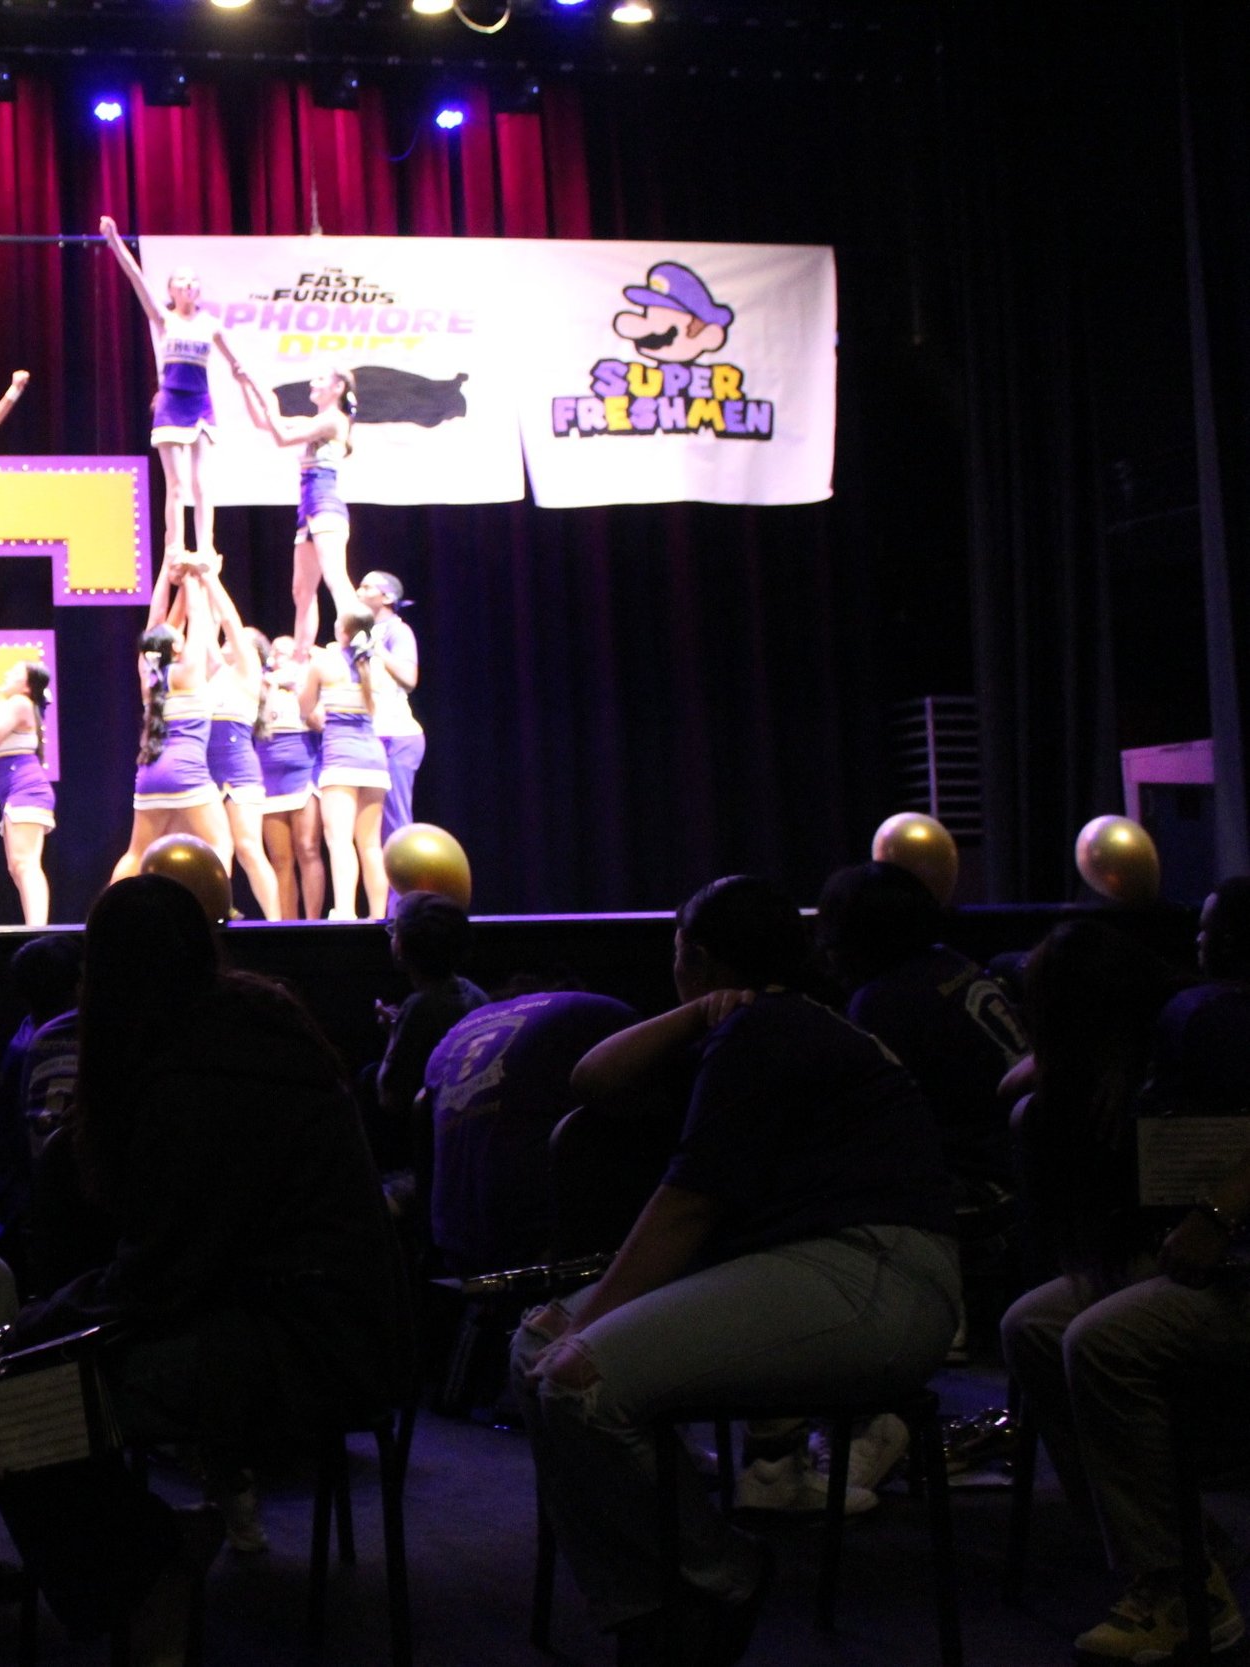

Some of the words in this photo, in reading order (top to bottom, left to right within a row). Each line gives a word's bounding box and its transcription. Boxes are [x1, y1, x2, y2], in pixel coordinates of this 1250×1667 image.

[297, 273, 365, 289] FAST
[272, 288, 395, 305] FURIOUS
[589, 358, 745, 401] SUPER
[552, 396, 774, 441] FRESHMEN
